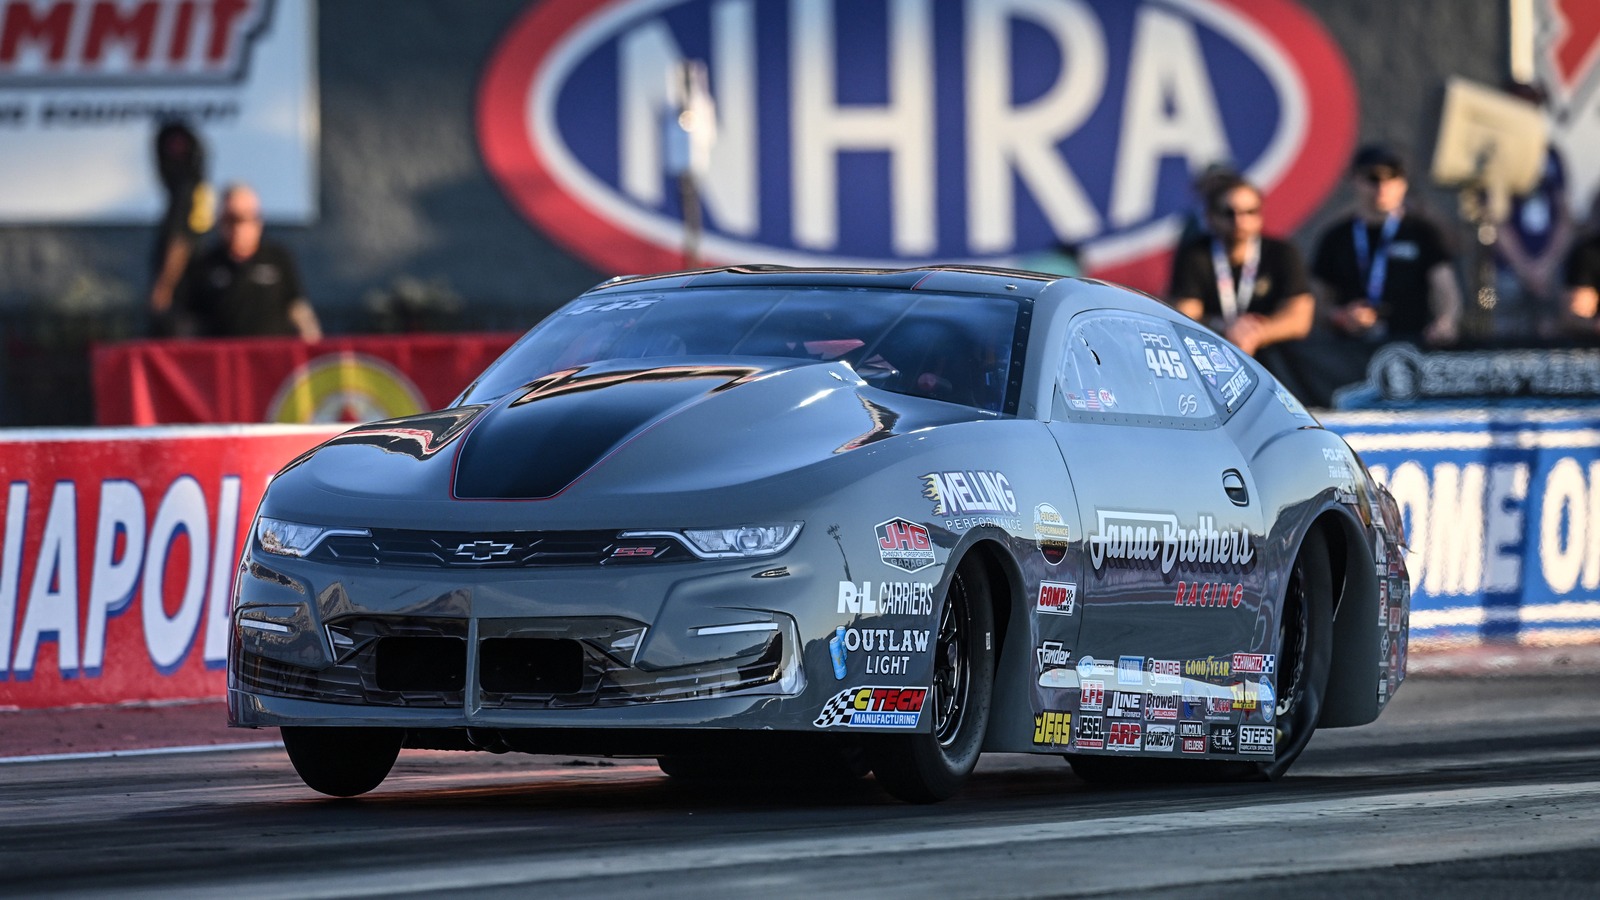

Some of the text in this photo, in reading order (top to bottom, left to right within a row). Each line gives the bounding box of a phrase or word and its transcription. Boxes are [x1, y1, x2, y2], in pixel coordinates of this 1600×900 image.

[614, 0, 1234, 258] NHRA
[1140, 332, 1172, 350] PRO
[1144, 348, 1189, 379] 445
[934, 471, 1018, 514] MELLING
[879, 522, 930, 550] JHG
[946, 520, 1023, 531] PERFORMANCE
[1368, 460, 1530, 596] OME
[1162, 516, 1254, 574] Brothers
[891, 558, 928, 569] GARAGE
[878, 581, 934, 615] CARRIERS
[1040, 585, 1067, 606] COMP
[1174, 581, 1244, 608] RACING
[844, 629, 930, 652] OUTLAW
[865, 655, 910, 675] LIGHT
[1233, 655, 1262, 671] SCHWARTZ
[1146, 692, 1178, 709] Browell
[854, 713, 916, 726] MANUFACTURING
[1034, 711, 1072, 745] JEGS
[1075, 716, 1104, 740] JESEL
[1181, 724, 1202, 736] LINCOLN
[1107, 722, 1141, 745] ARP
[1146, 730, 1175, 747] COMETIC
[1241, 727, 1273, 744] STEF'S
[1184, 740, 1204, 751] WELDERS
